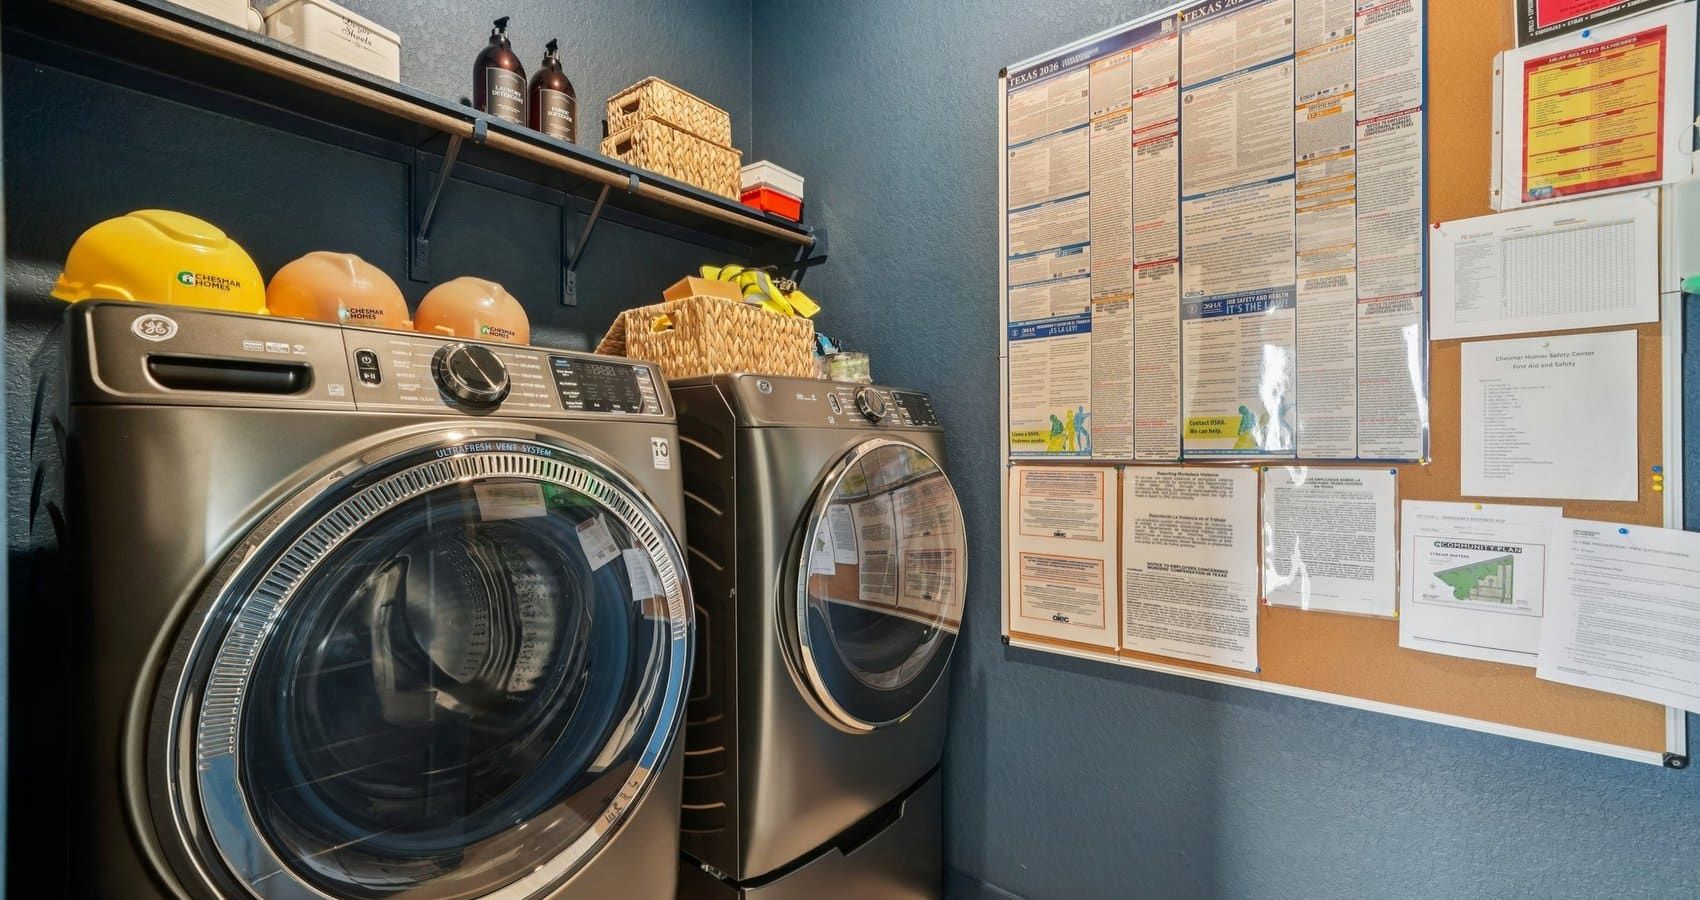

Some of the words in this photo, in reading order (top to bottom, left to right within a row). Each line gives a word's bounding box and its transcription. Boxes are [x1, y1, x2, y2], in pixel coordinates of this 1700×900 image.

[1184, 1, 1222, 22] TEXAS
[341, 27, 373, 47] Sheets
[1009, 70, 1038, 87] TEXAS
[1039, 61, 1059, 76] 2026
[492, 90, 524, 105] DETERGENT
[495, 85, 521, 98] LAUNDRY
[195, 273, 241, 288] CHESMAR
[195, 280, 231, 291] HOMES
[1236, 296, 1255, 304] SAFETY
[1268, 291, 1289, 300] HEALTH
[1226, 303, 1243, 314] IT'S
[1245, 302, 1261, 312] THE
[489, 331, 510, 339] HOMES
[490, 326, 516, 336] CHESMAR
[1512, 362, 1527, 370] First
[1554, 360, 1576, 368] Safety
[435, 442, 491, 458] ULTRAFRESH
[496, 442, 517, 451] VENT
[521, 444, 552, 457] SYSTEM
[1440, 541, 1497, 552] COMMUNITY
[1499, 545, 1523, 554] PLAN
[1170, 567, 1205, 575] COMPENSATION
[1197, 566, 1229, 574] CONCERNING
